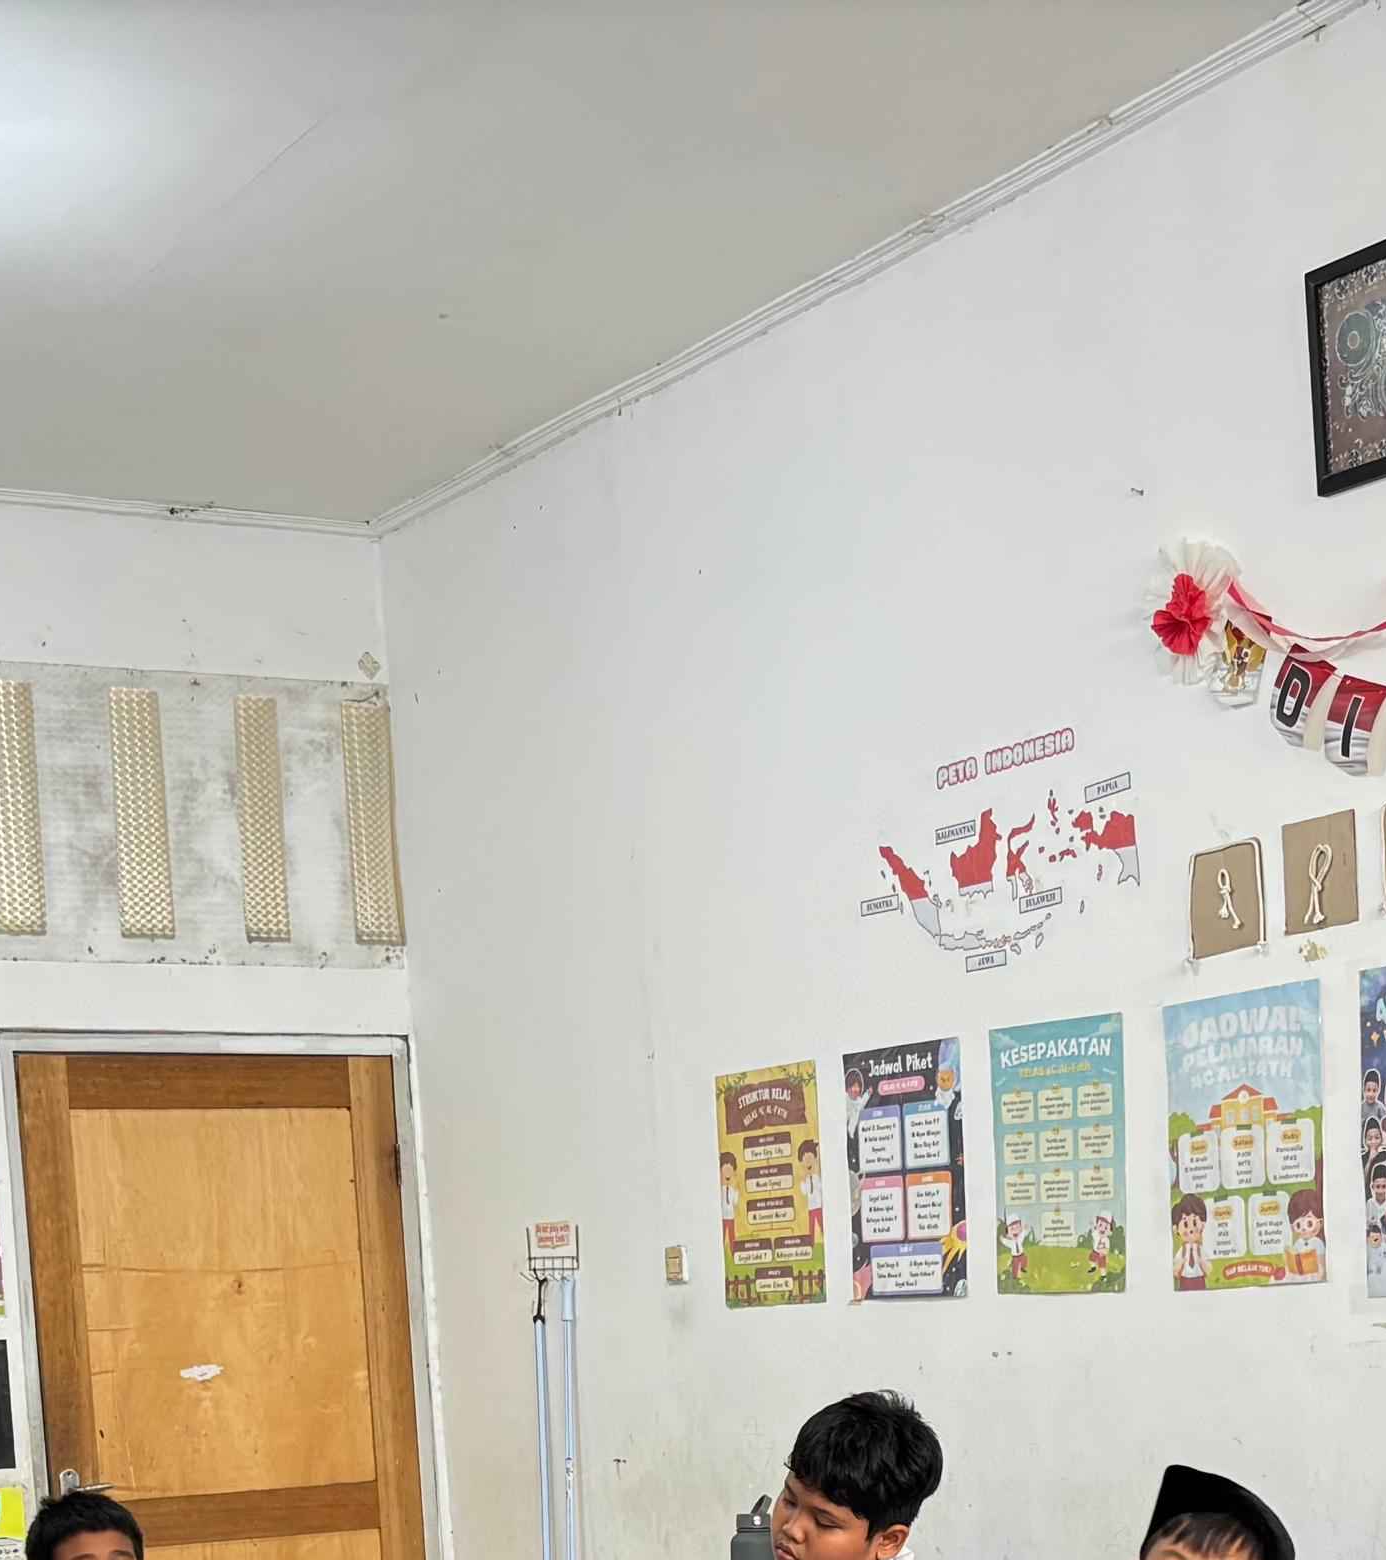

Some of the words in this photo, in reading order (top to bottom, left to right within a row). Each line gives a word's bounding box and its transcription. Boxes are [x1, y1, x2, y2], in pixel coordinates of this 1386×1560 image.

[937, 757, 978, 790] PETA
[984, 727, 1076, 775] INDONESIA
[1096, 779, 1119, 796] PAPUA
[1182, 1005, 1301, 1049] JADWAL
[868, 1055, 902, 1077] Jadwal
[905, 1052, 933, 1072] Piket
[1000, 1037, 1111, 1069] KESEPAKATAN
[1182, 1036, 1303, 1073] PELAJARAN
